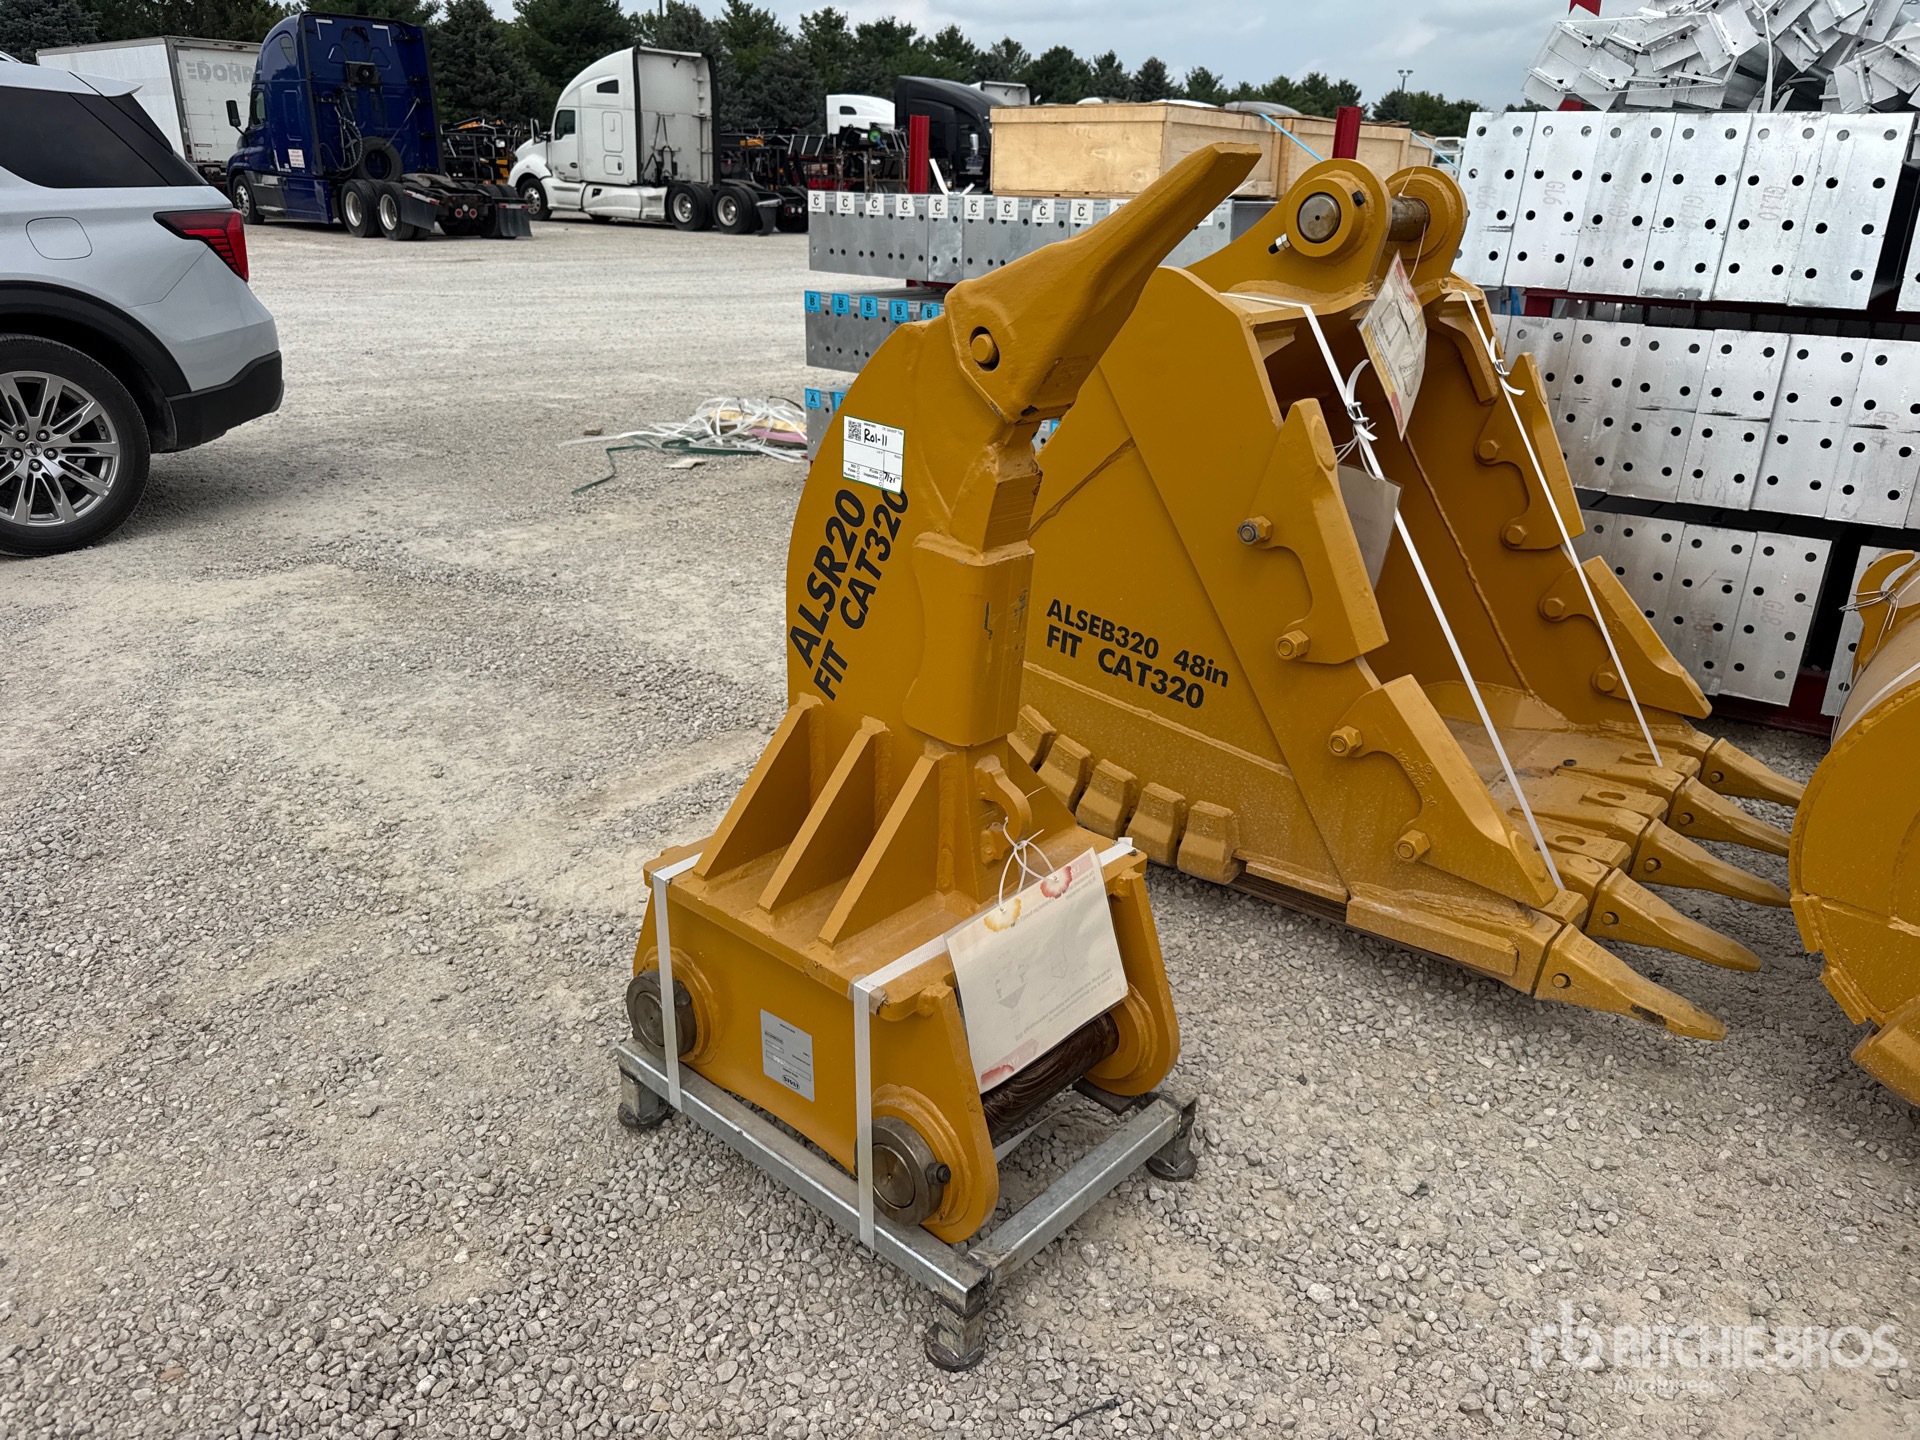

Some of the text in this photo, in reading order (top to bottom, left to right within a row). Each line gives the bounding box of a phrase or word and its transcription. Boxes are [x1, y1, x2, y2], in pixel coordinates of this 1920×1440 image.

[813, 196, 820, 206] C
[842, 198, 849, 208] C
[871, 199, 878, 209] C
[901, 200, 908, 210] C
[934, 202, 942, 212] C
[970, 203, 977, 213] C
[1003, 203, 1011, 214] C
[1039, 205, 1047, 216] C
[1077, 206, 1085, 217] C
[809, 297, 816, 306] B
[838, 299, 844, 309] B
[866, 302, 872, 312] B
[896, 306, 903, 316] B
[926, 309, 933, 319] B
[810, 394, 816, 403] A
[789, 489, 866, 669] ALSR20
[813, 488, 909, 701] FIT CAT320
[1046, 598, 1229, 688] ALSEB320 48in
[1046, 624, 1205, 709] FIT CAT320
